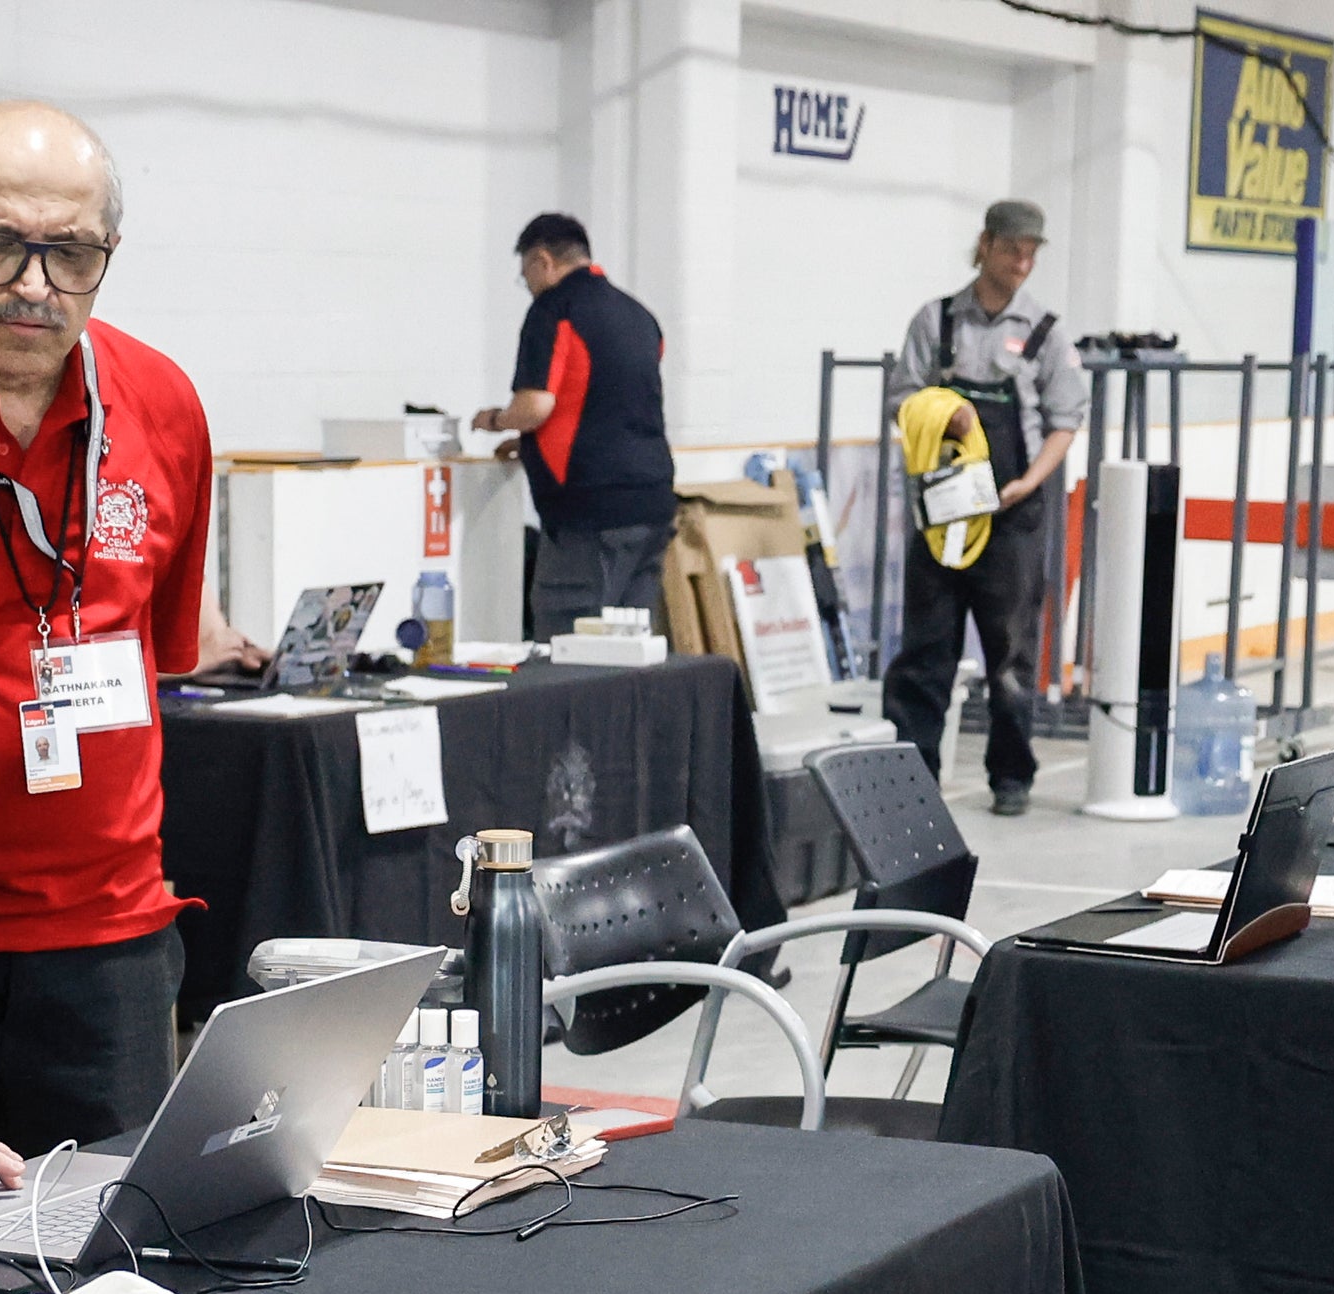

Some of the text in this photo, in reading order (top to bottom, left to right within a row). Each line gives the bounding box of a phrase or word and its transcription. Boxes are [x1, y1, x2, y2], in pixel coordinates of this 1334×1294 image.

[773, 86, 859, 160] HOME
[1224, 119, 1309, 206] Value
[107, 537, 132, 550] CEMA
[51, 678, 123, 694] ATHNAKARA
[71, 696, 105, 708] ERTA
